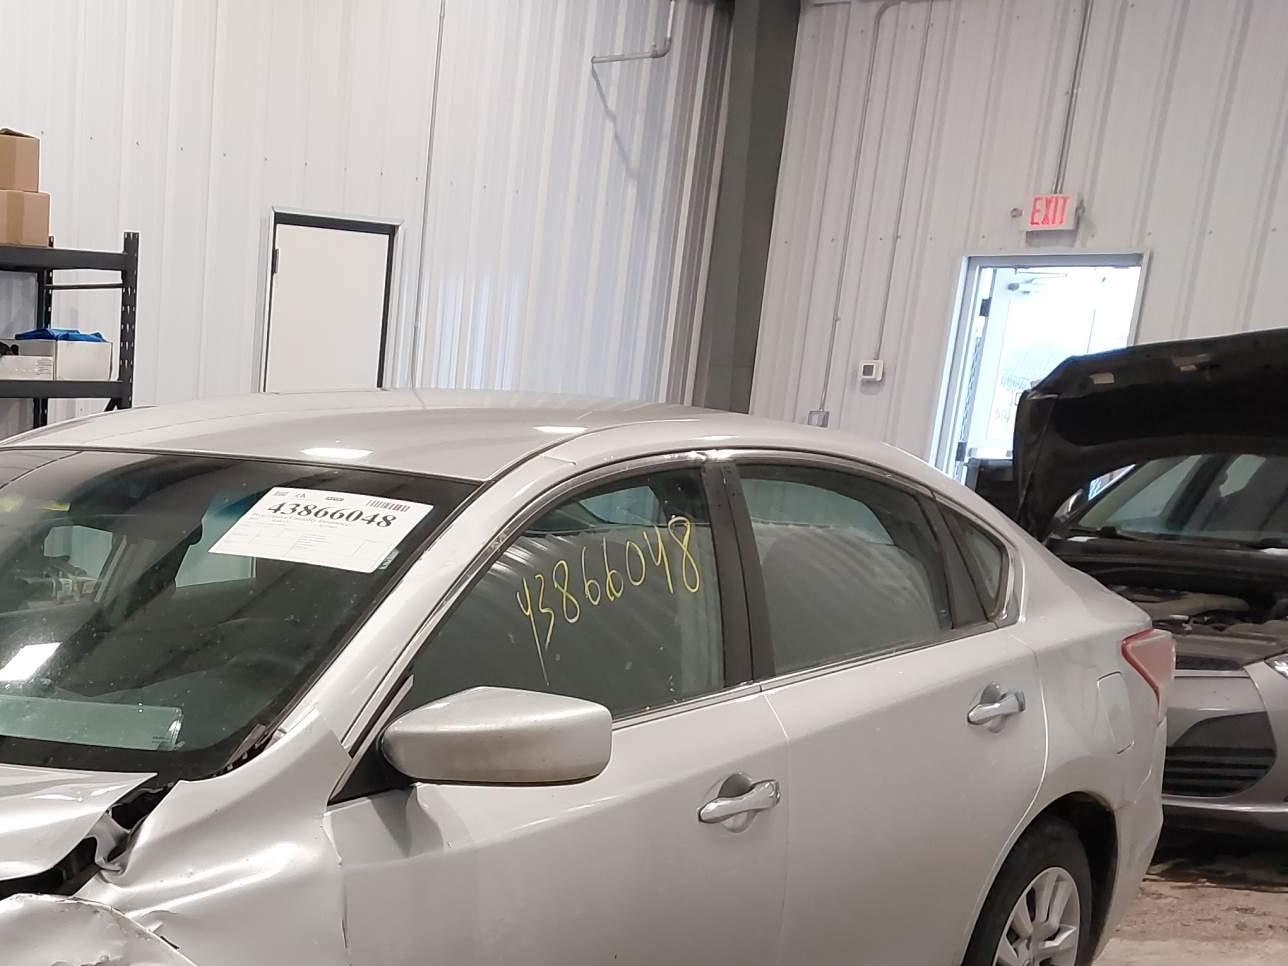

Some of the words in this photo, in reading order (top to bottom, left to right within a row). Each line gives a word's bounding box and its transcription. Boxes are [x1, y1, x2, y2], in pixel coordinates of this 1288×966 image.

[1030, 195, 1068, 225] EXIT
[267, 502, 397, 528] 43866048
[517, 516, 700, 687] 43866048
